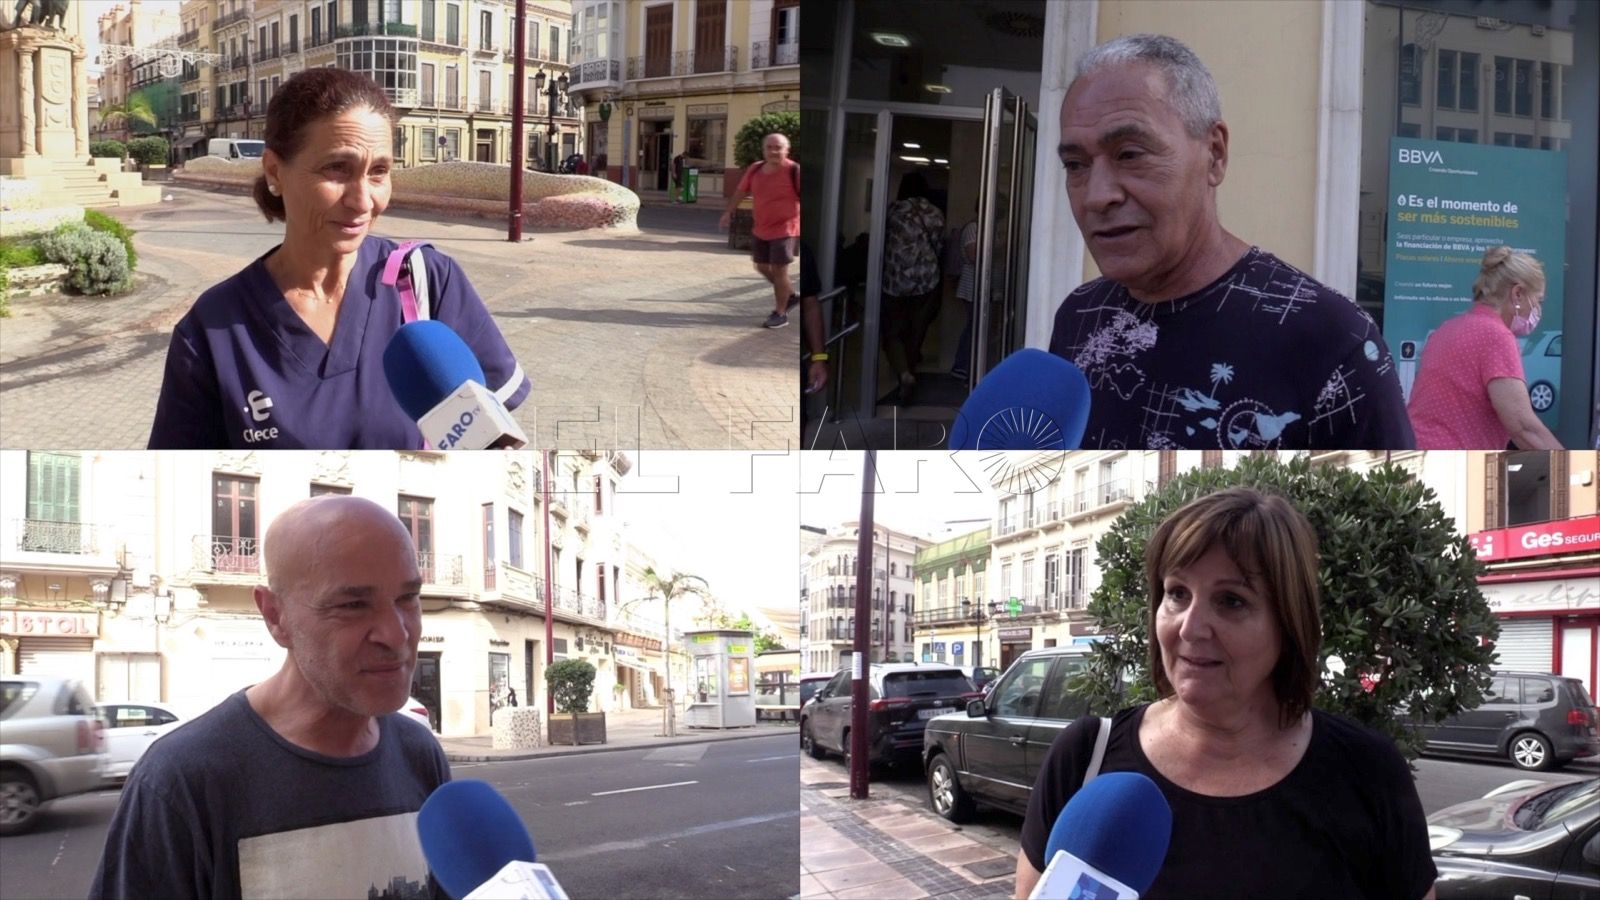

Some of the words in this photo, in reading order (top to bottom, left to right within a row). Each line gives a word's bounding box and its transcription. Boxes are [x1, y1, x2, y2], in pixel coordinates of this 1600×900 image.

[1398, 148, 1443, 164] BBVA
[1408, 194, 1424, 207] Es
[1426, 196, 1438, 209] el
[1441, 199, 1501, 212] momento
[1503, 199, 1518, 214] de
[1397, 212, 1417, 223] ser
[1420, 211, 1447, 225] más
[1450, 214, 1519, 229] sostenibles
[1452, 243, 1470, 251] BBVA
[242, 426, 279, 443] Clece
[438, 411, 474, 450] FARO
[1521, 531, 1564, 549] Ges
